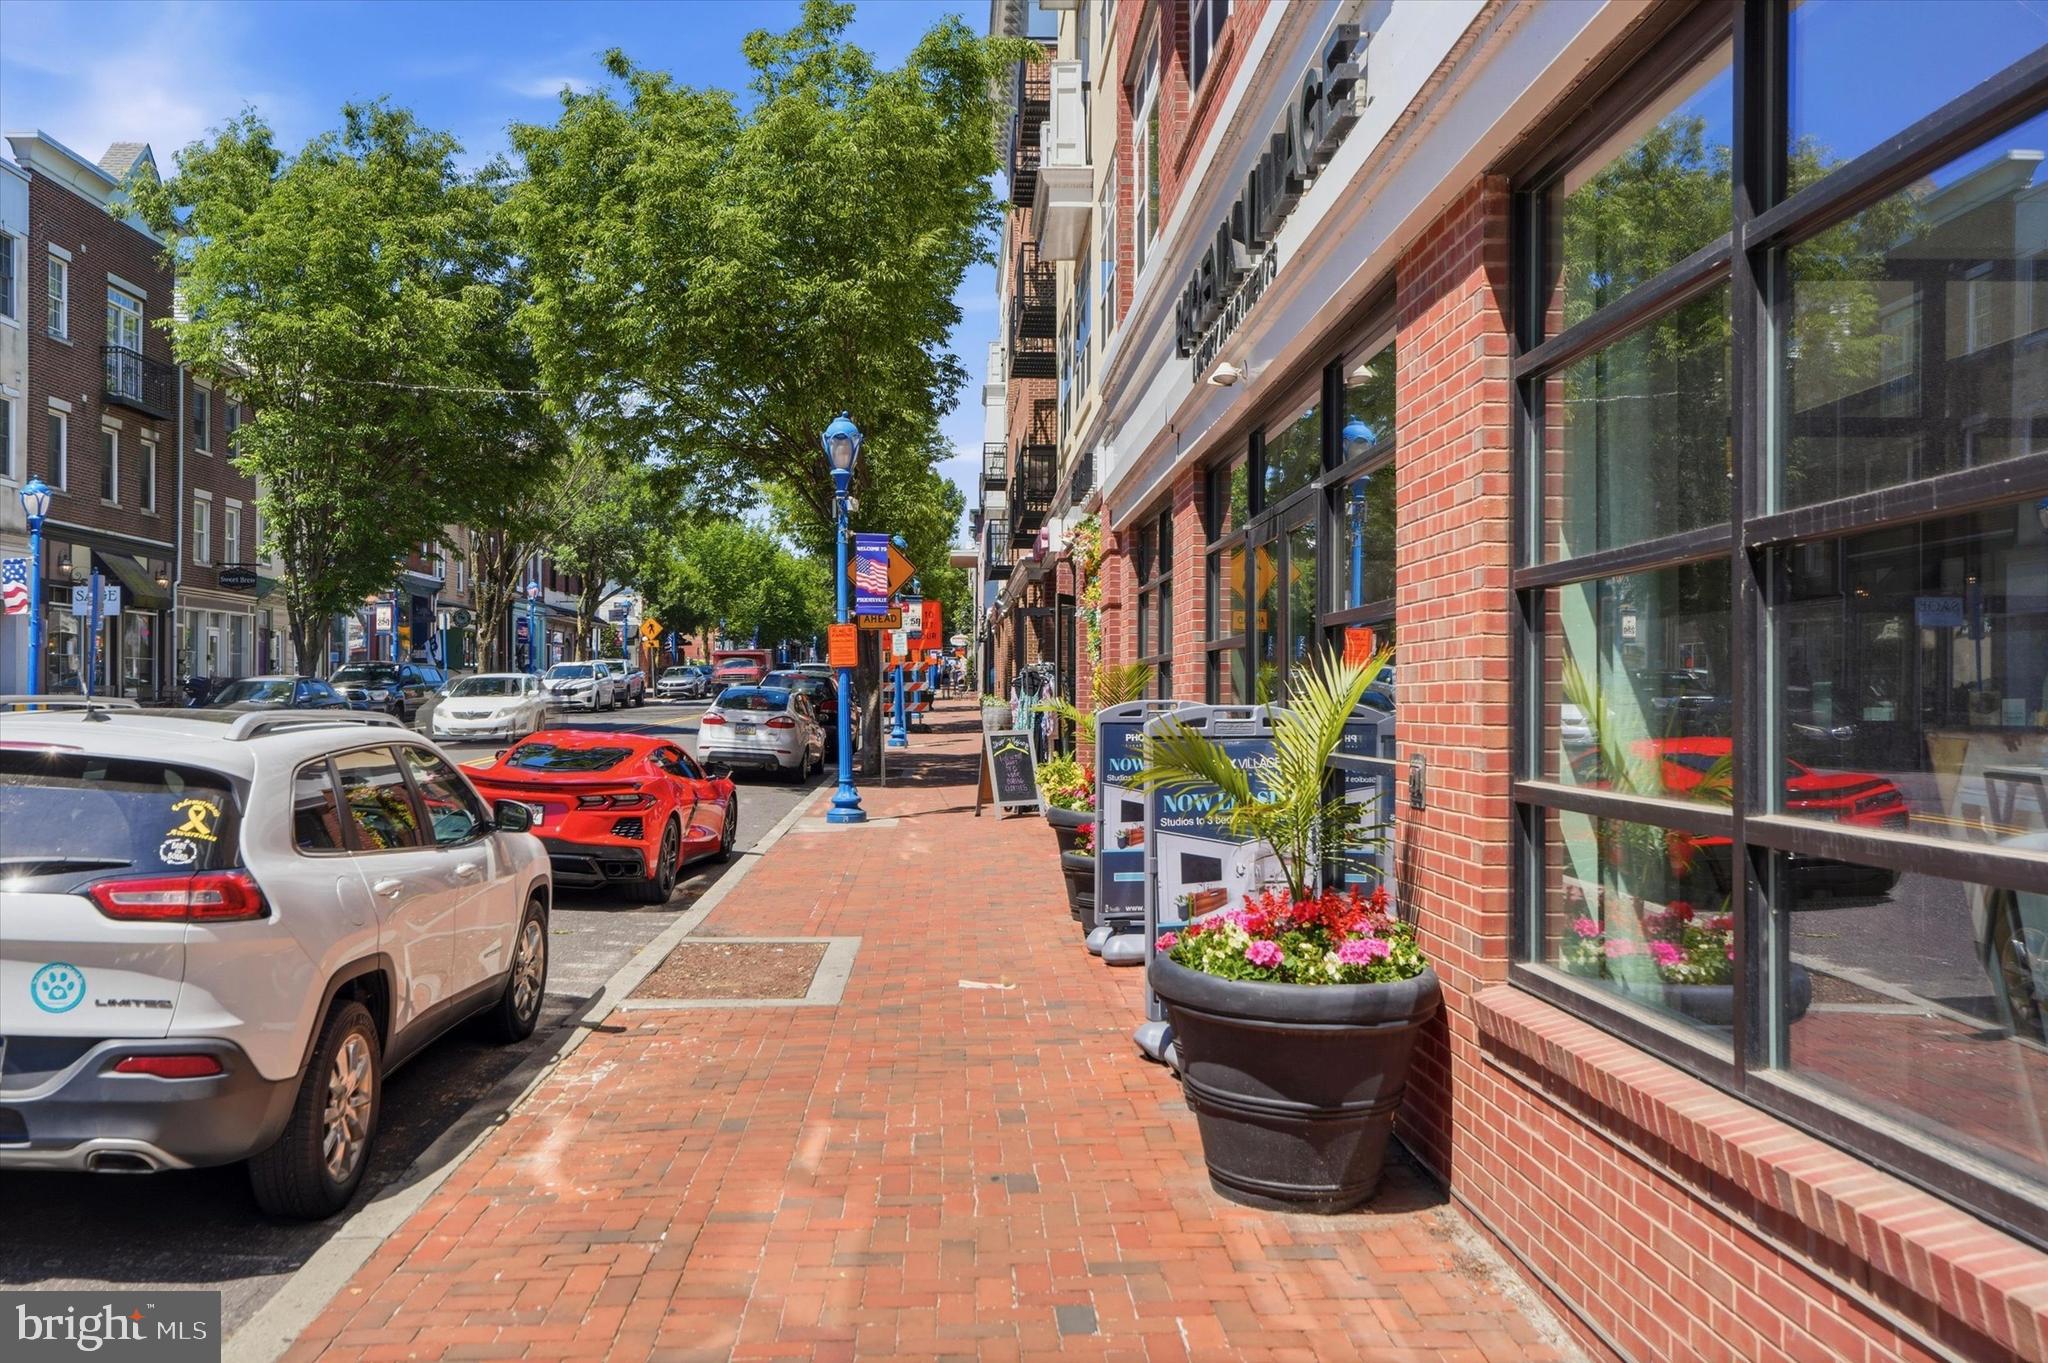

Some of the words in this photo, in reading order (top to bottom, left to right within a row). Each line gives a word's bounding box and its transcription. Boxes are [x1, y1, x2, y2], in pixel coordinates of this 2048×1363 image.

[75, 590, 118, 601] SE
[864, 614, 897, 623] AHEAD
[1163, 793, 1213, 813] NOW
[1160, 817, 1194, 827] Studios
[1196, 816, 1205, 825] to
[1207, 815, 1213, 825] 3
[95, 999, 173, 1008] LIMITED
